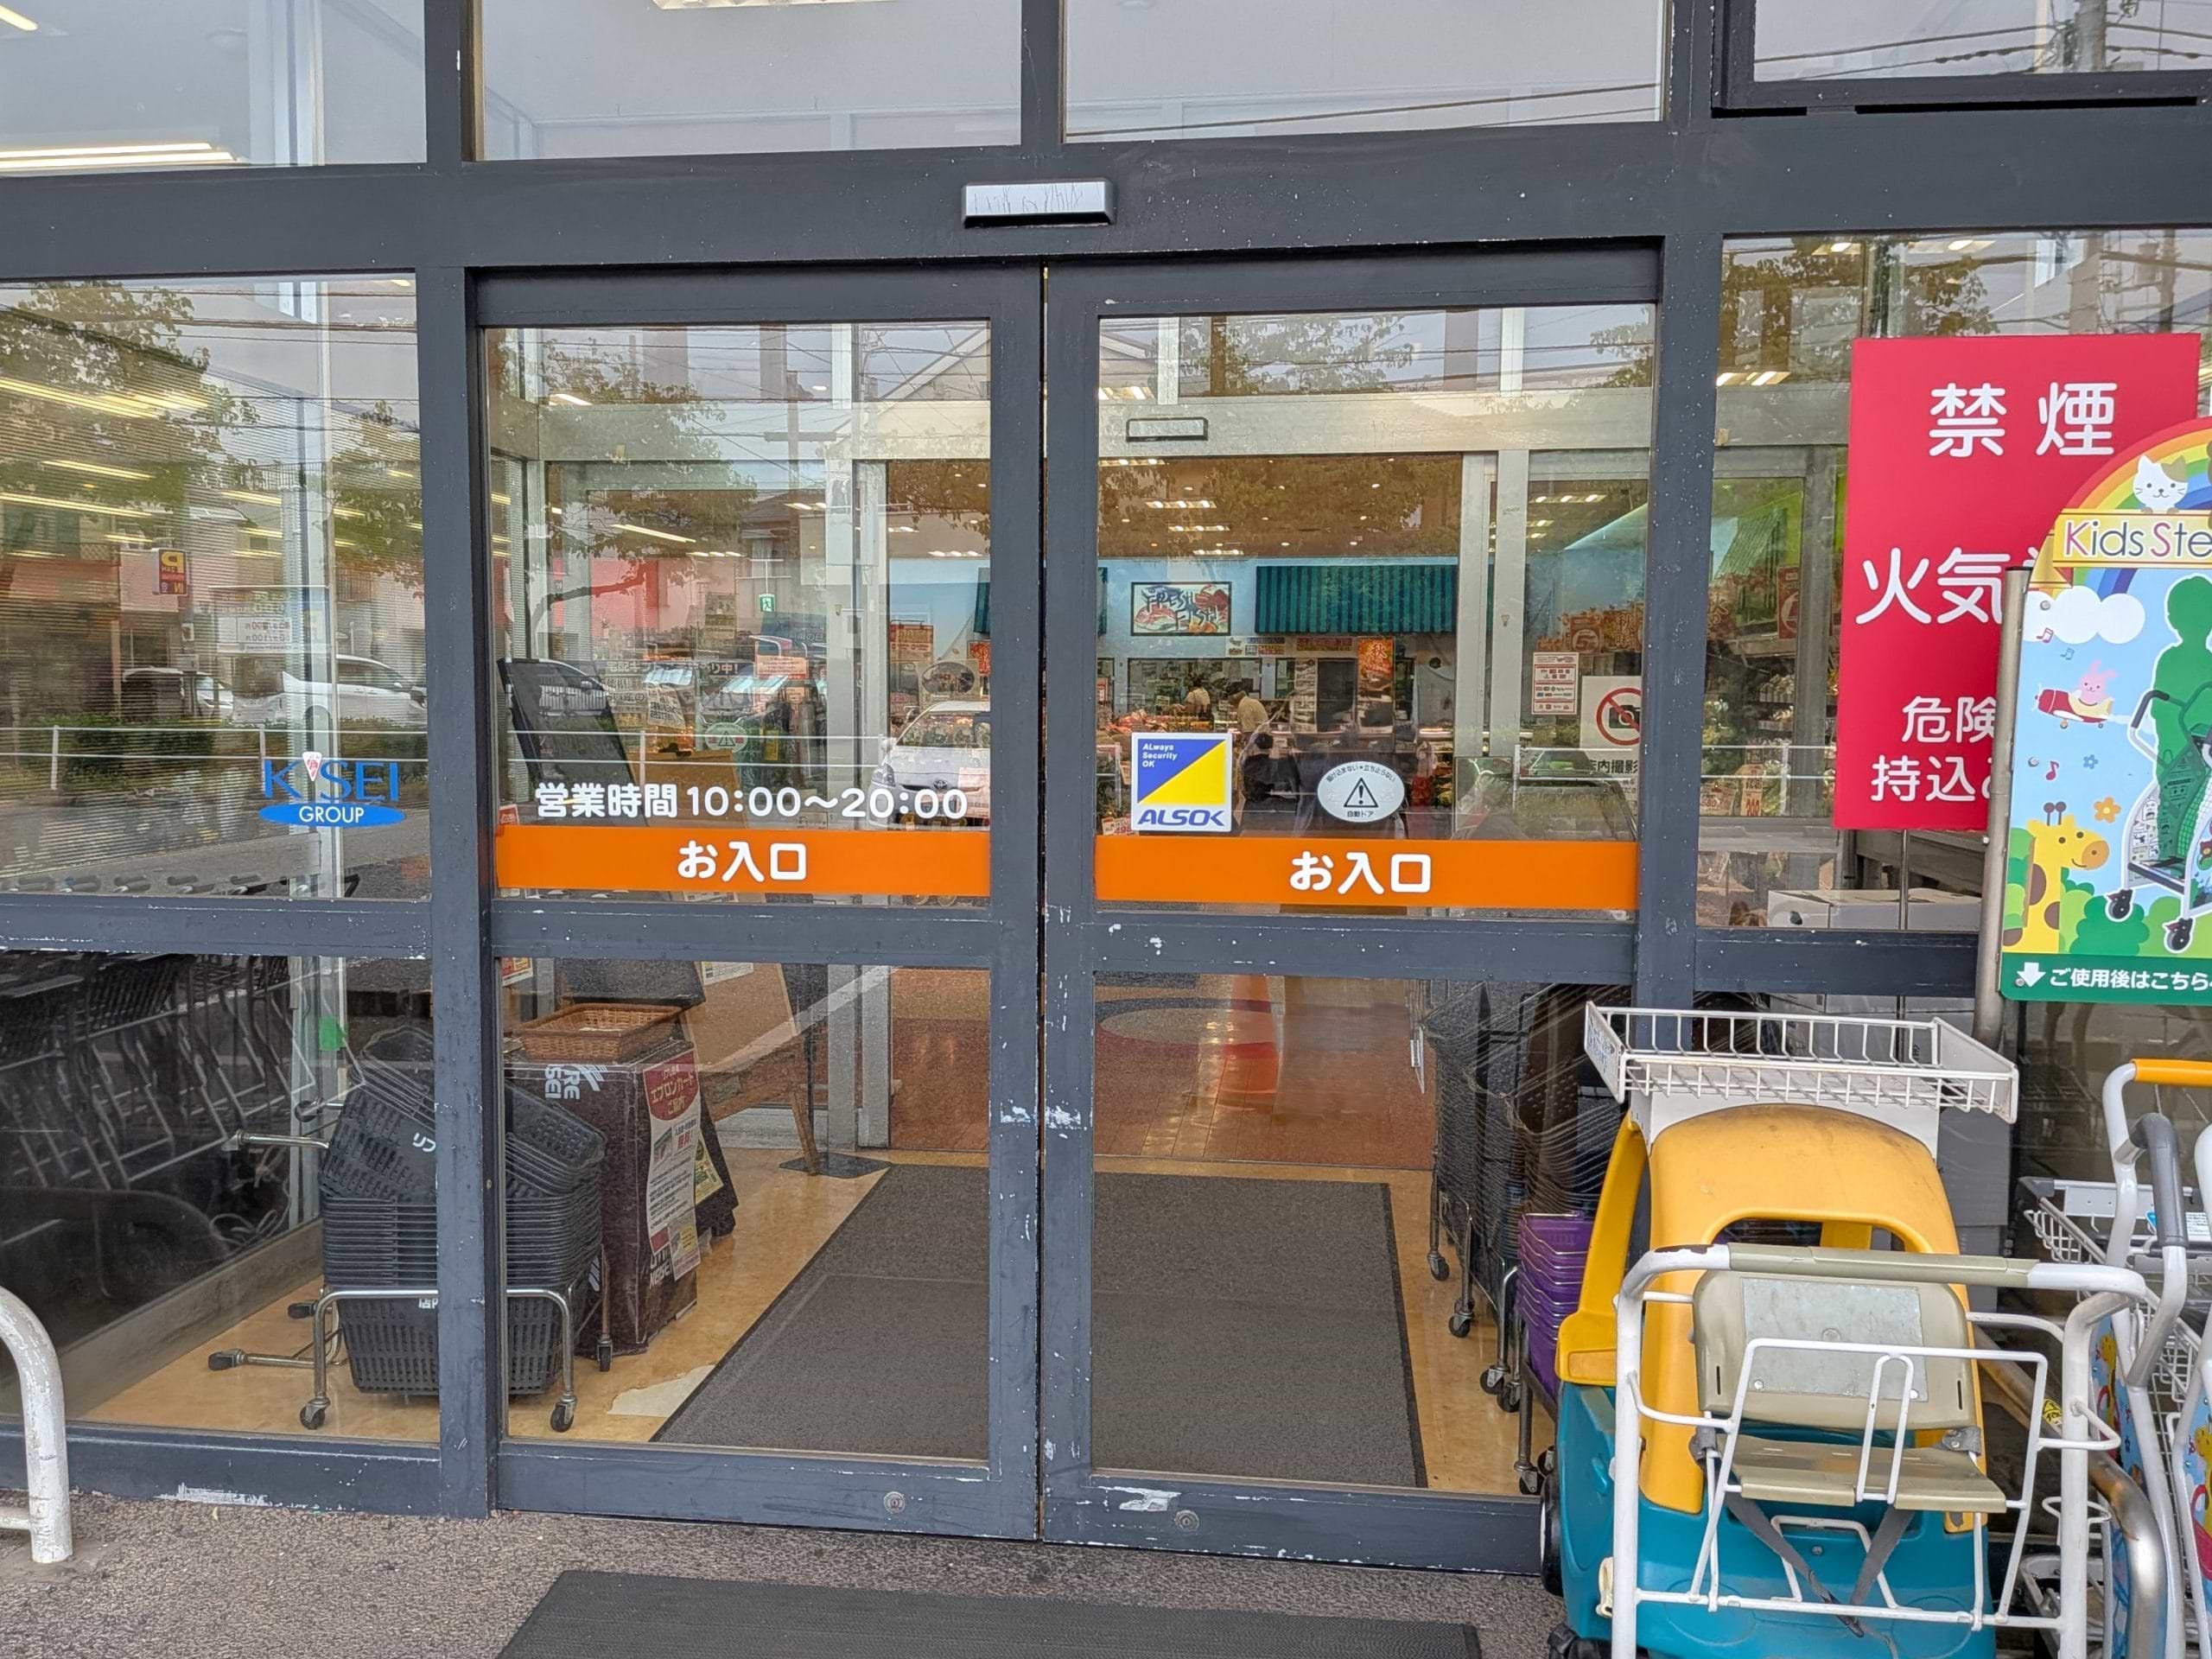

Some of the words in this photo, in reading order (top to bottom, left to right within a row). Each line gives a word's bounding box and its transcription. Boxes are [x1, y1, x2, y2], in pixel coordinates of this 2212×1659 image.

[1929, 382, 2117, 457] 禁煙
[2065, 520, 2144, 557] Kids
[1855, 547, 2039, 625] 火気
[1142, 752, 1178, 761] Security
[299, 805, 365, 823] GROUP
[535, 782, 677, 818] 営業時間
[1137, 809, 1225, 826] ALSOK
[677, 840, 806, 882] お入口
[1289, 850, 1432, 895] お入口
[2050, 967, 2212, 991] ご使用後はこちら
